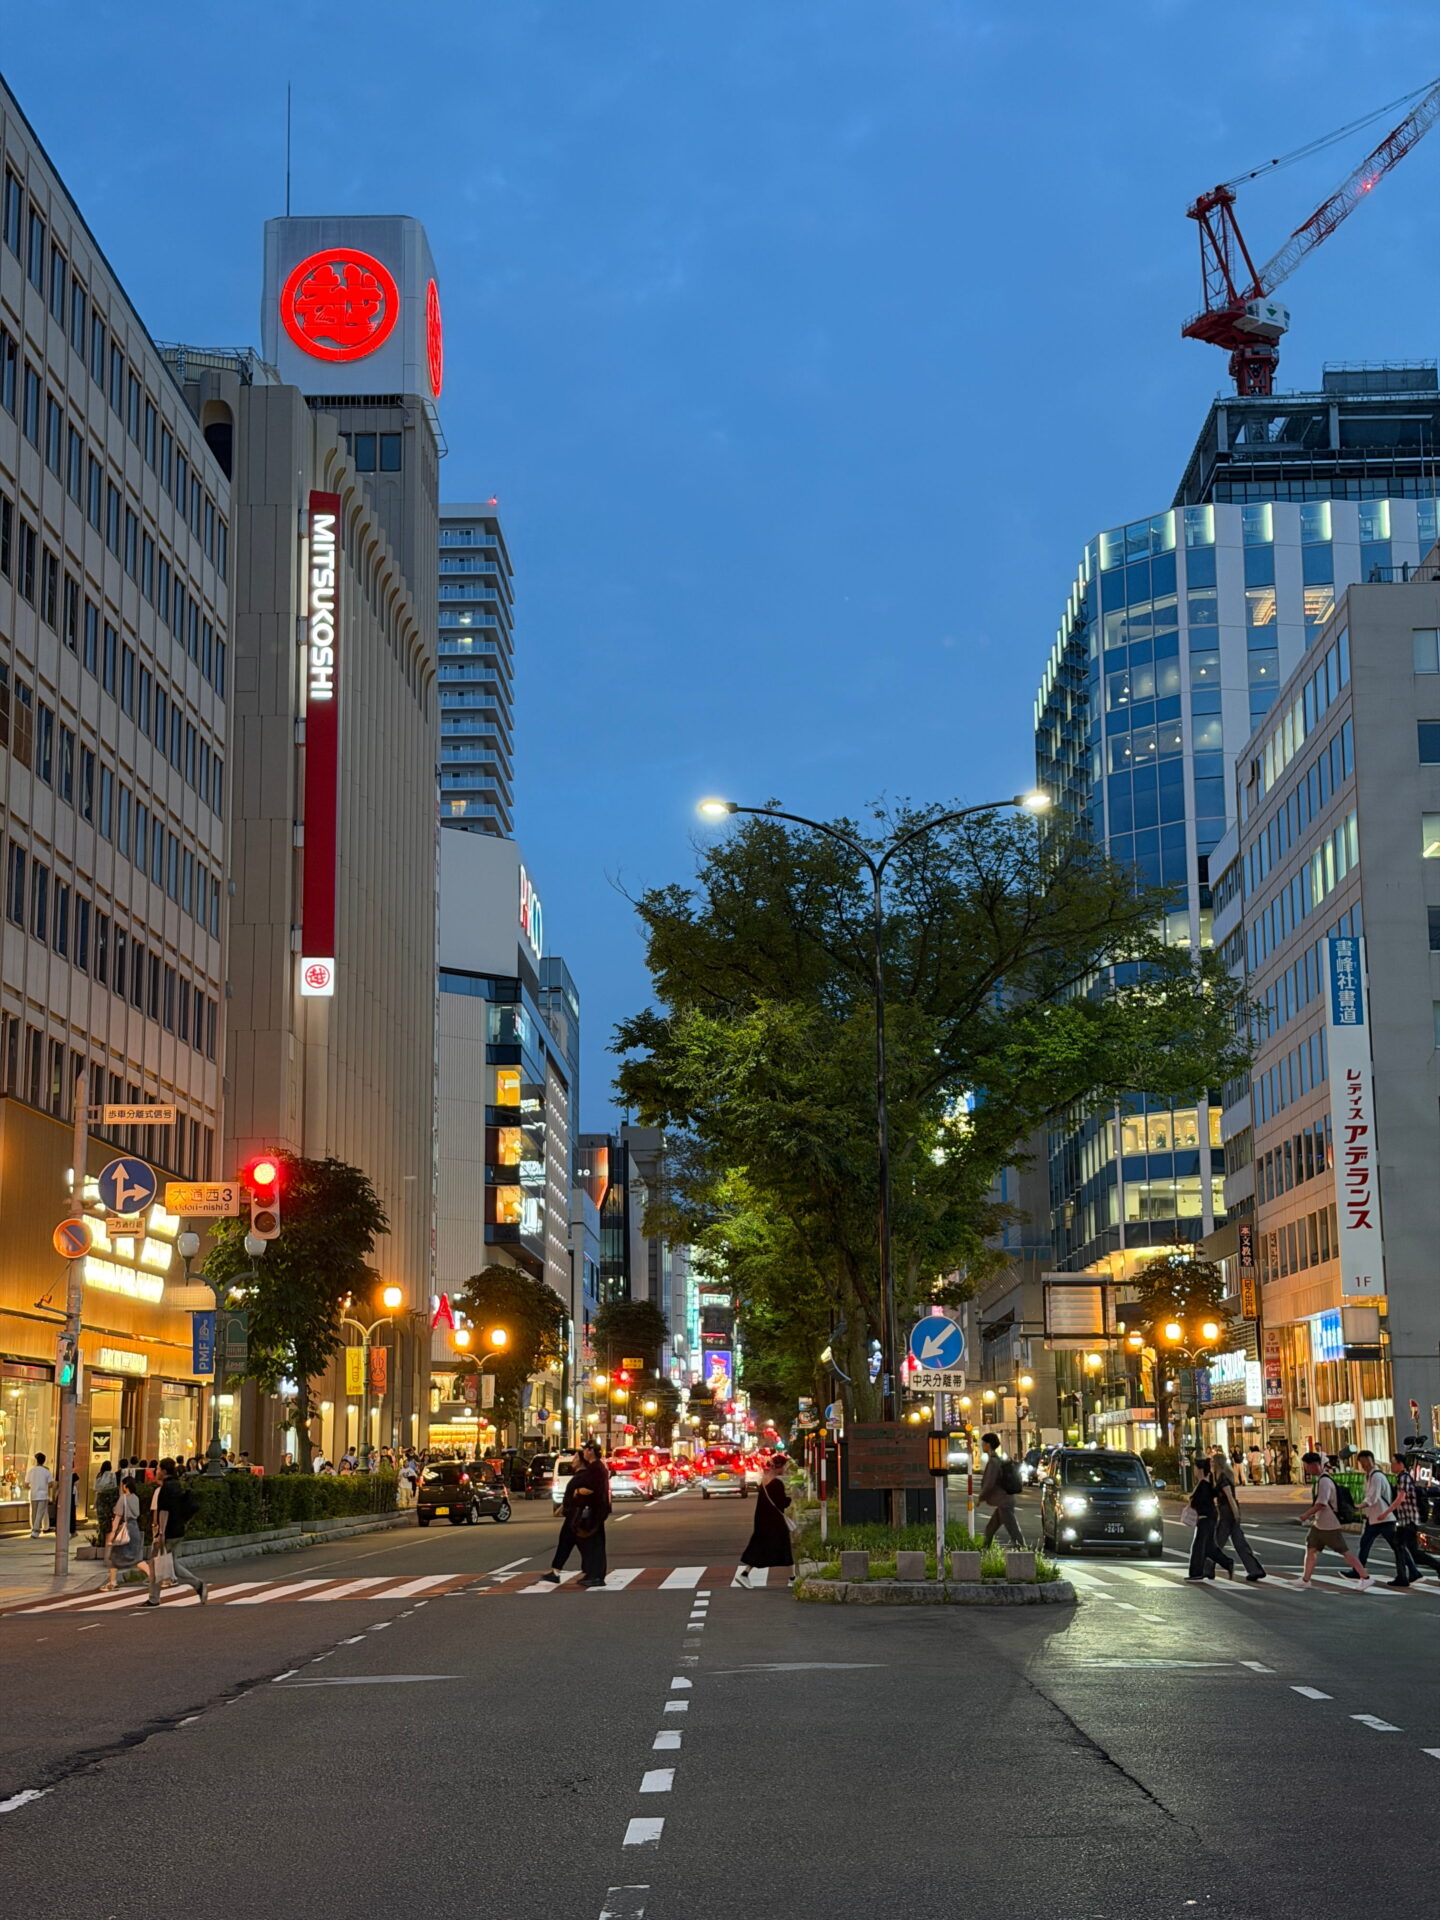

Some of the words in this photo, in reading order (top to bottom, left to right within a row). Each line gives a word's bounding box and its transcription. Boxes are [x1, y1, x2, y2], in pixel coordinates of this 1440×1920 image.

[310, 514, 336, 700] MITSUKOSHI
[1335, 939, 1357, 1024] 書峰社書道
[108, 1109, 172, 1119] 歩車分離式信号
[172, 1188, 233, 1202] 大通西3
[1354, 1276, 1372, 1288] 1F
[198, 1343, 210, 1371] PMF
[913, 1374, 962, 1388] 中央分離帯
